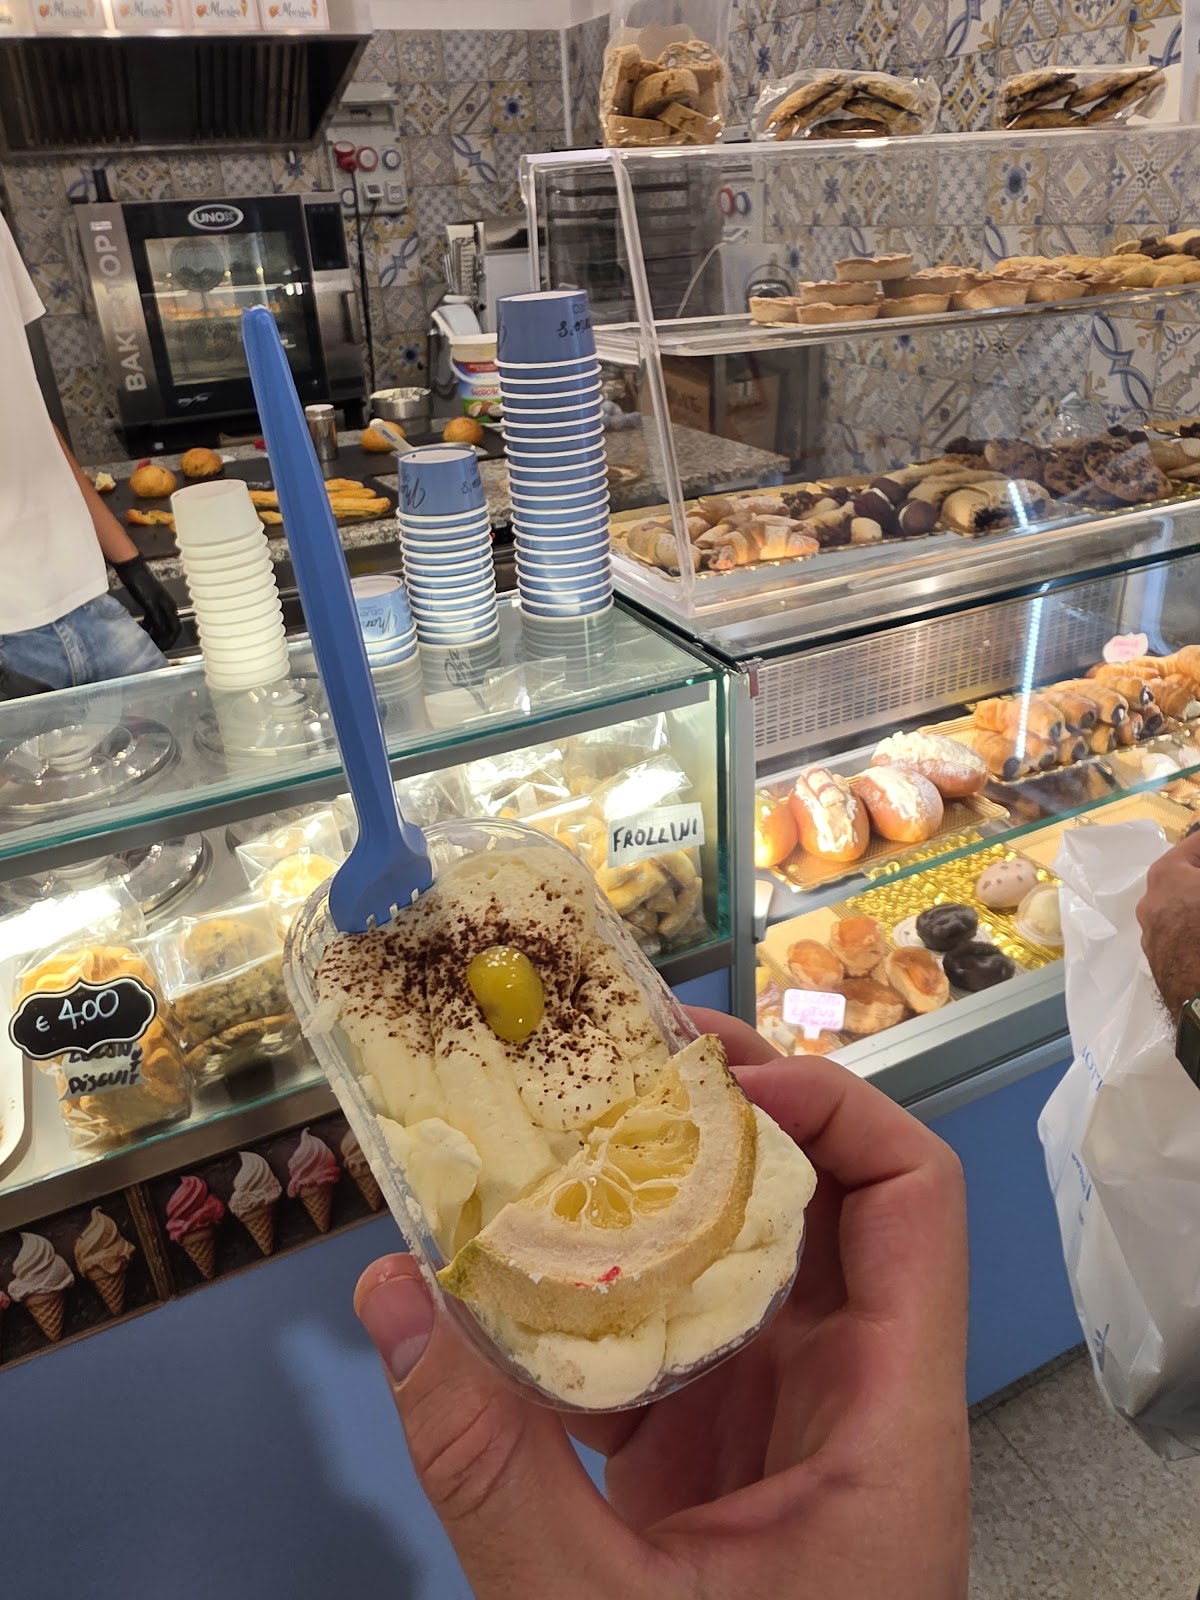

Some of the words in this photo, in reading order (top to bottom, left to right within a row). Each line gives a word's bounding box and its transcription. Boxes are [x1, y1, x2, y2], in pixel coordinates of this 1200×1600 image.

[195, 211, 234, 223] UNOX
[613, 818, 698, 852] FROLLINI
[36, 1015, 50, 1032] €
[58, 989, 119, 1030] 4.00
